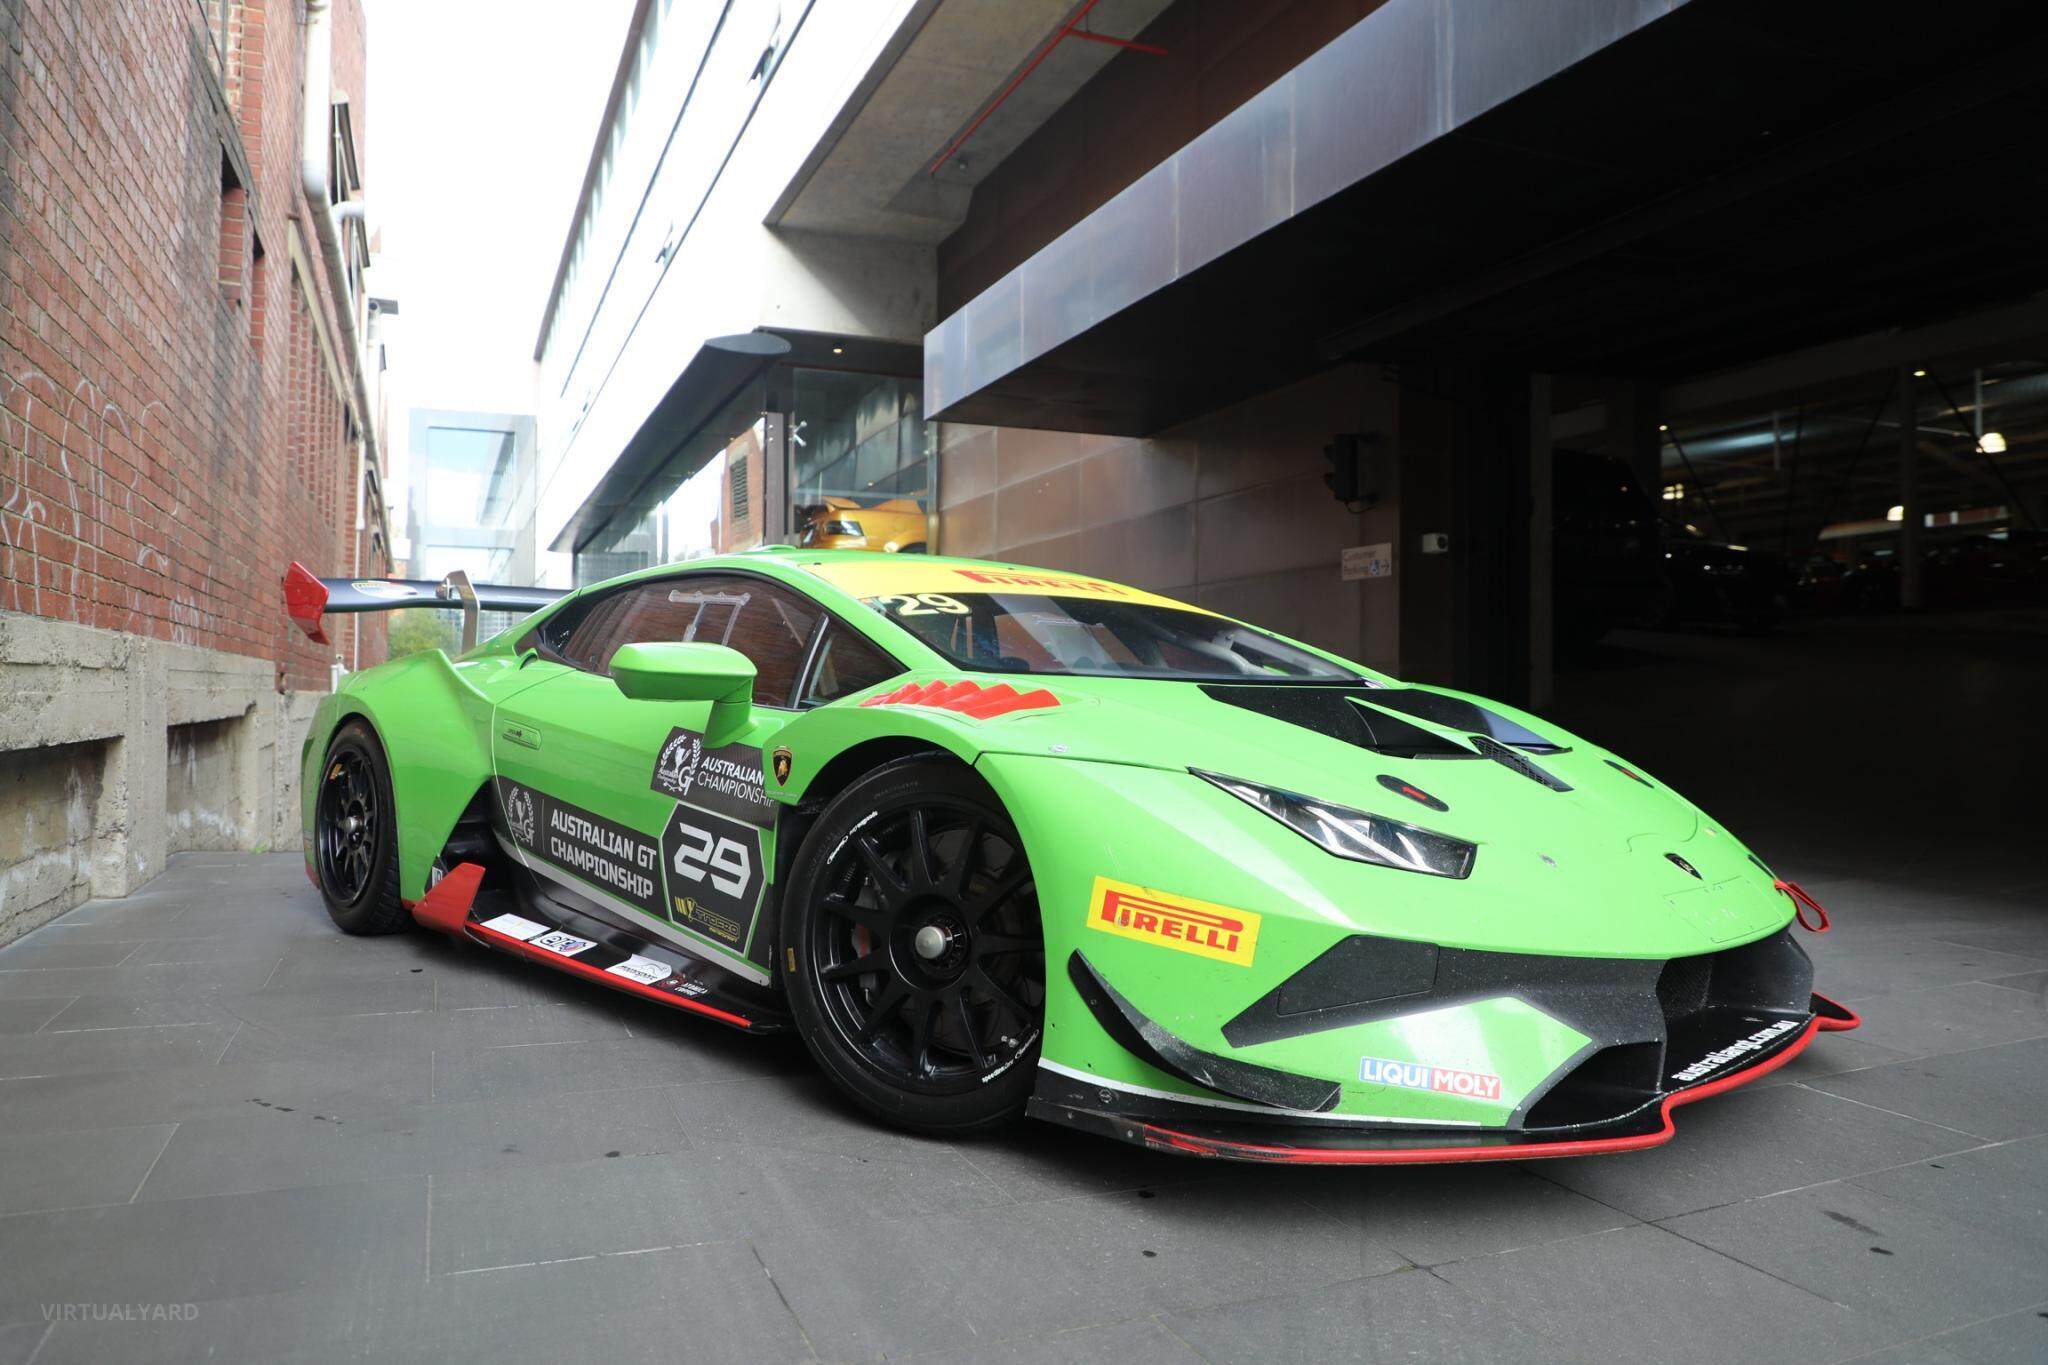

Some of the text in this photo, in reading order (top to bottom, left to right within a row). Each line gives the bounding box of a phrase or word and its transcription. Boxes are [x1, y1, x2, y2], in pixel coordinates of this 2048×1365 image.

[879, 593, 969, 616] 29
[701, 756, 765, 786] AUSTRALIAN
[551, 808, 657, 870] AUSTRALIAN GT
[551, 836, 653, 899] CHAMPIONSHIP
[673, 822, 751, 900] 29
[1101, 889, 1244, 953] PIRELLI
[1363, 1059, 1499, 1096] LIQUI MOLY
